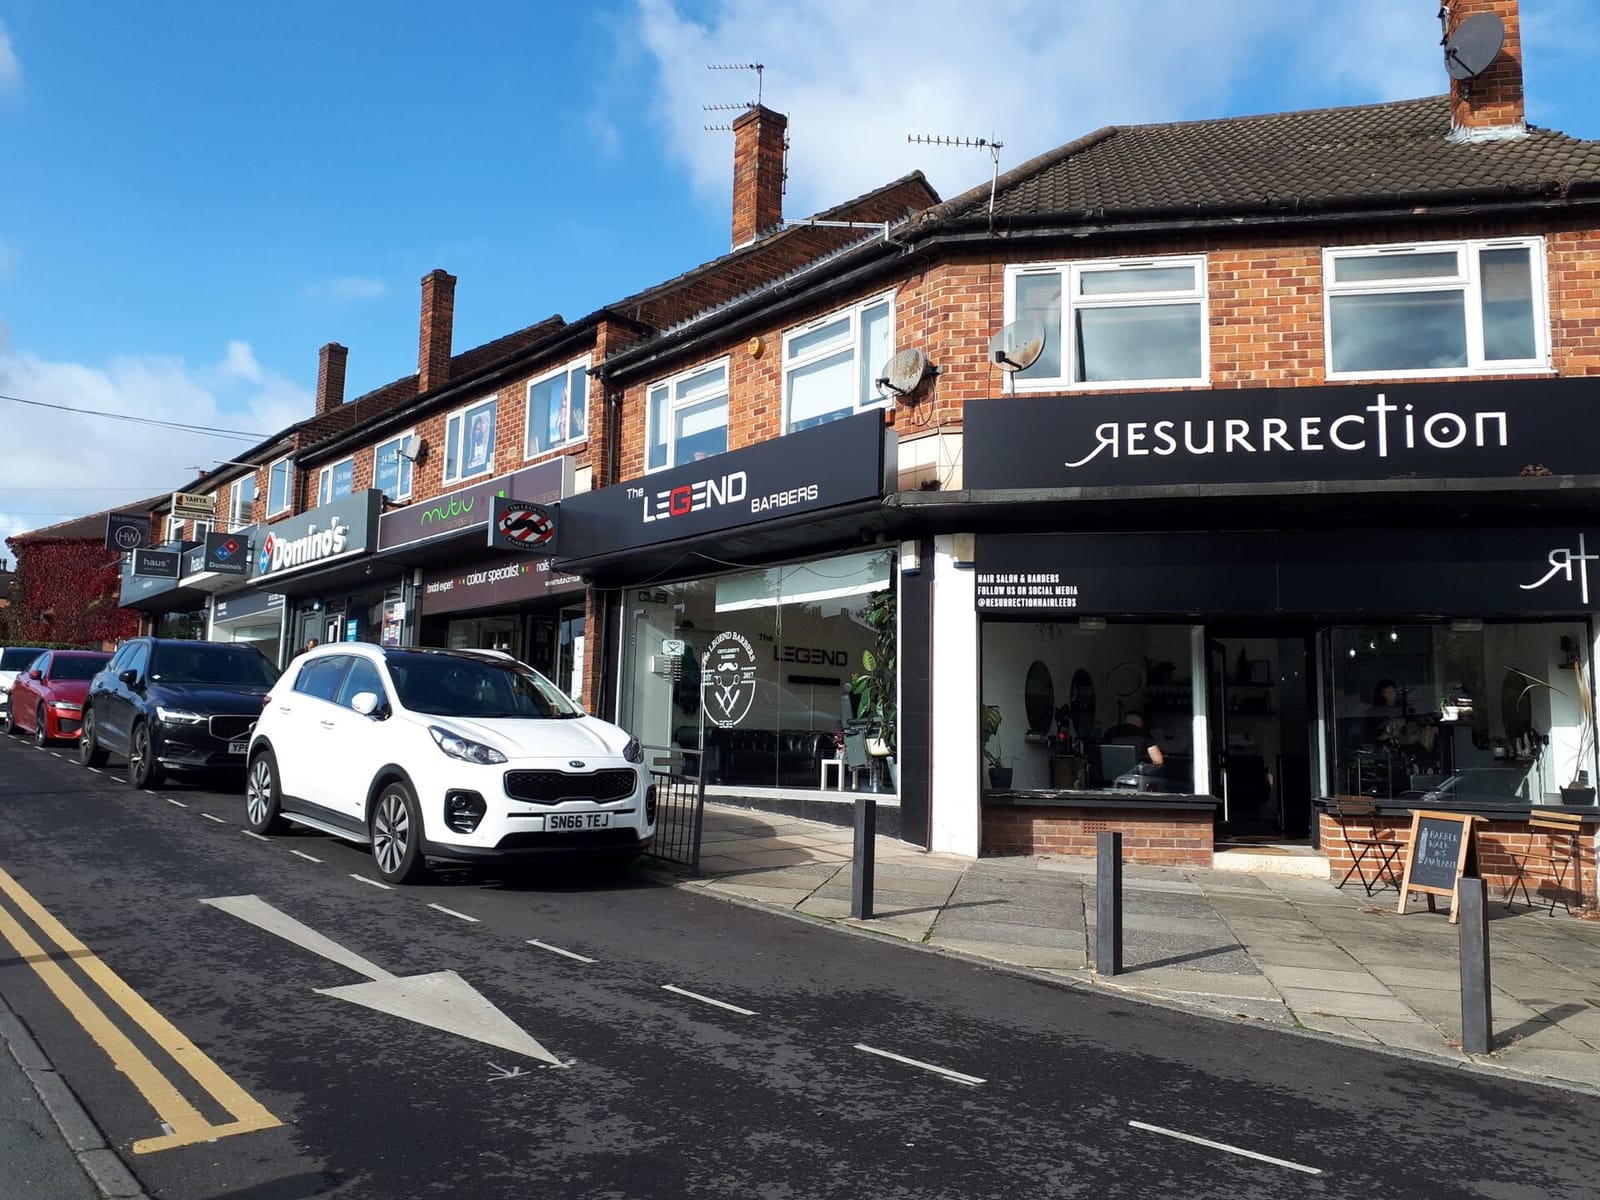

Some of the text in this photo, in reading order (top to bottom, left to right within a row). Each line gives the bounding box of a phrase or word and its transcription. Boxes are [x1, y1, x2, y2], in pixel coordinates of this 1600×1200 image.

[627, 470, 819, 523] The LEGEND BARBERS
[272, 516, 348, 571] Domino's
[143, 558, 166, 567] haus
[209, 561, 242, 571] Domino's
[536, 560, 550, 573] nails
[467, 562, 519, 586] colour specialist
[977, 574, 1059, 583] HAIR SALON & BARBERS
[427, 579, 454, 593] bridal expert
[977, 586, 1078, 595] FOLLOW US ON SOCIAL MEDIA
[977, 598, 1077, 607] @RESURRECTIONHAIRLEEDS
[774, 645, 847, 666] LEGEND
[550, 814, 609, 829] SN66 TEJ
[1429, 830, 1458, 842] BARBER
